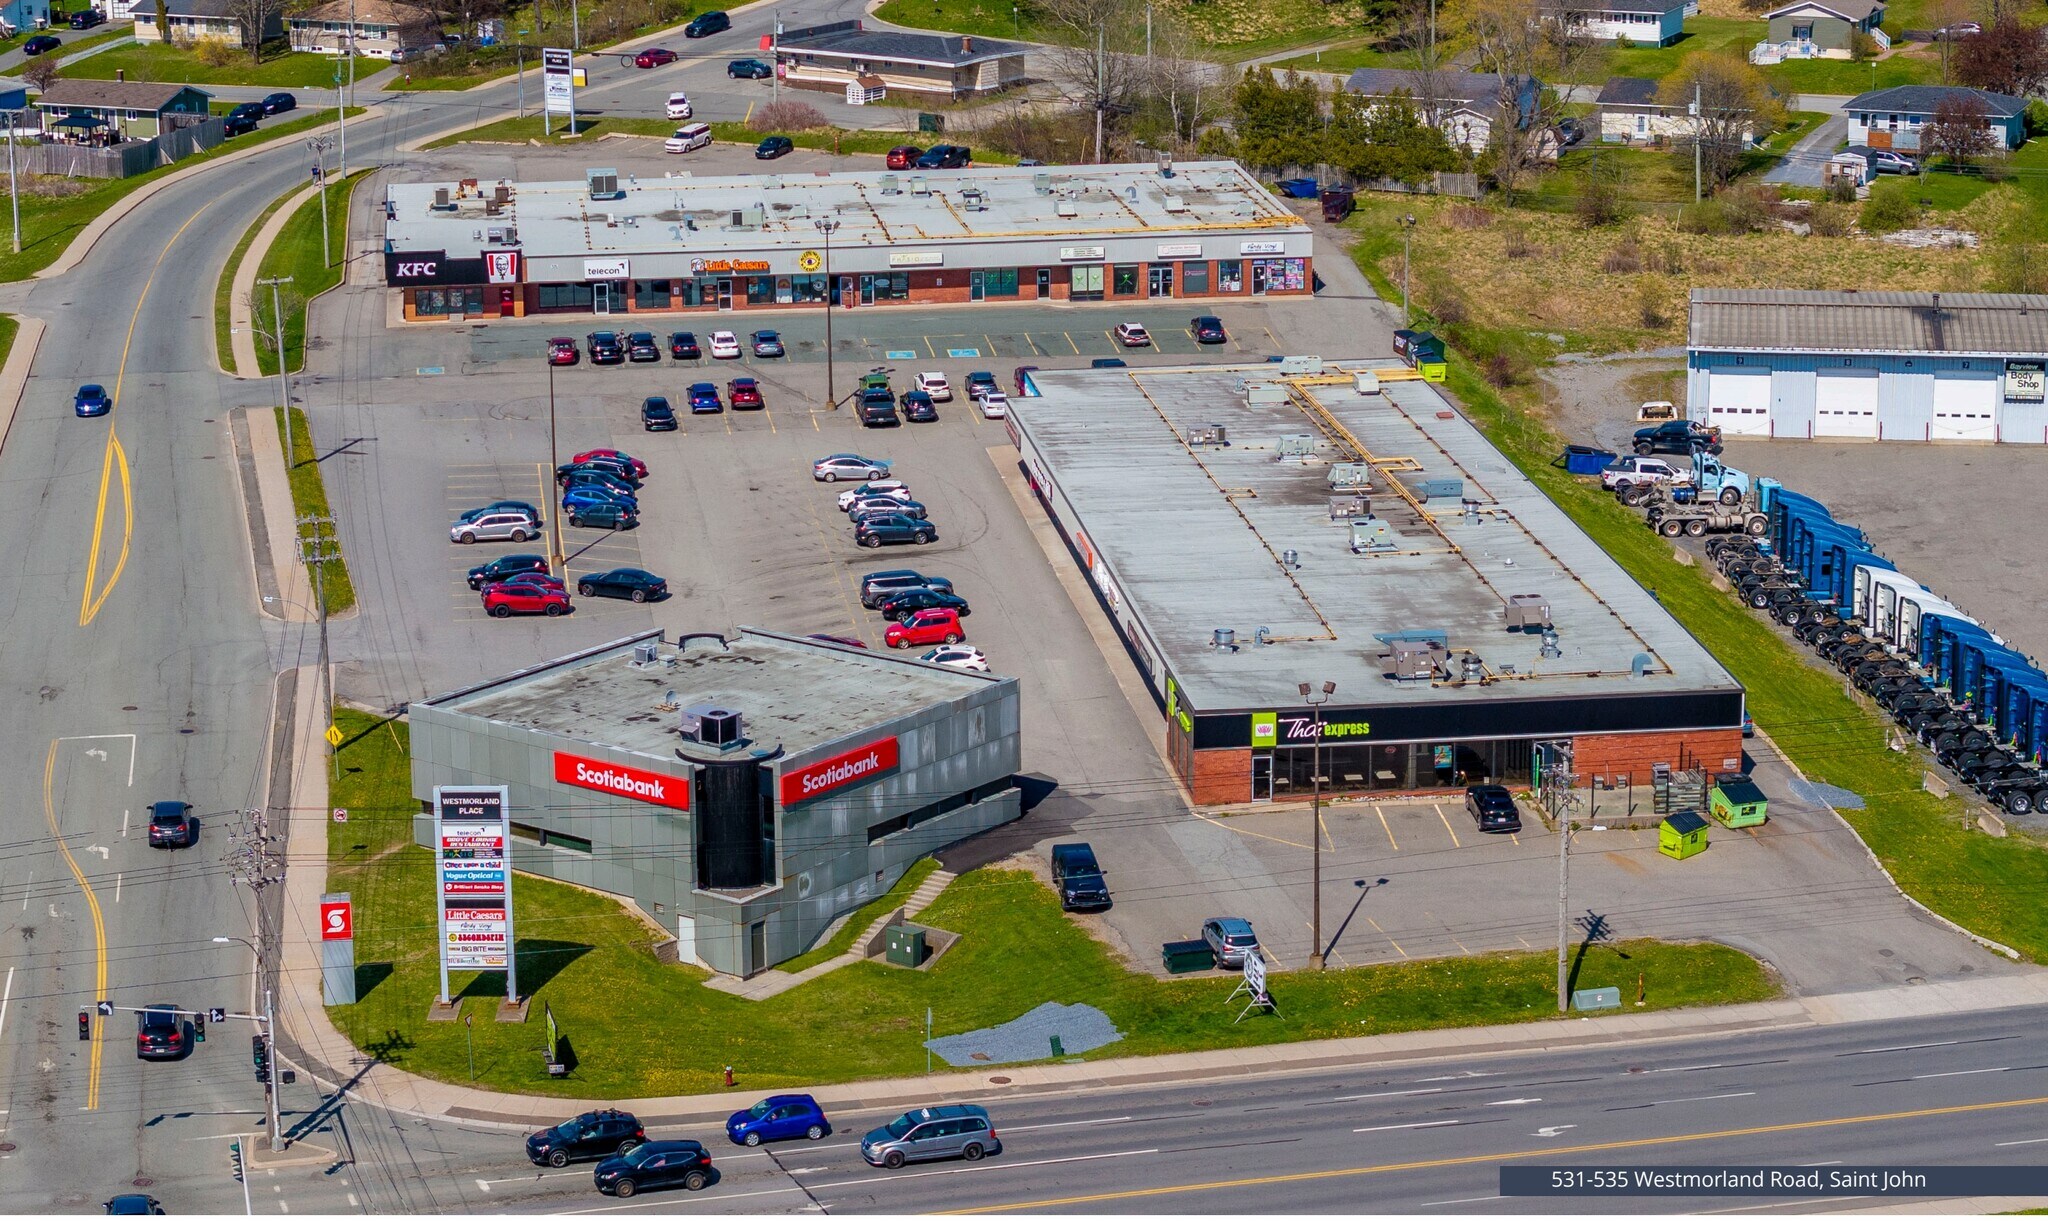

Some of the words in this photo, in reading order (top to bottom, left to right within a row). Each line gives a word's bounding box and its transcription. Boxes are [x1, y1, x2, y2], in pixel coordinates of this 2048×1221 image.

[396, 262, 436, 276] KFC
[706, 260, 731, 271] Little
[733, 259, 769, 270] Caesars
[588, 267, 620, 275] telecon
[2011, 371, 2033, 381] Body
[2017, 380, 2039, 389] Shop
[1324, 722, 1370, 737] express
[803, 751, 879, 793] Scotiabank
[577, 762, 665, 799] Scotiabank
[446, 872, 467, 880] Vogue
[468, 872, 493, 880] Optical
[448, 911, 470, 919] Little
[471, 911, 503, 919] Caesars
